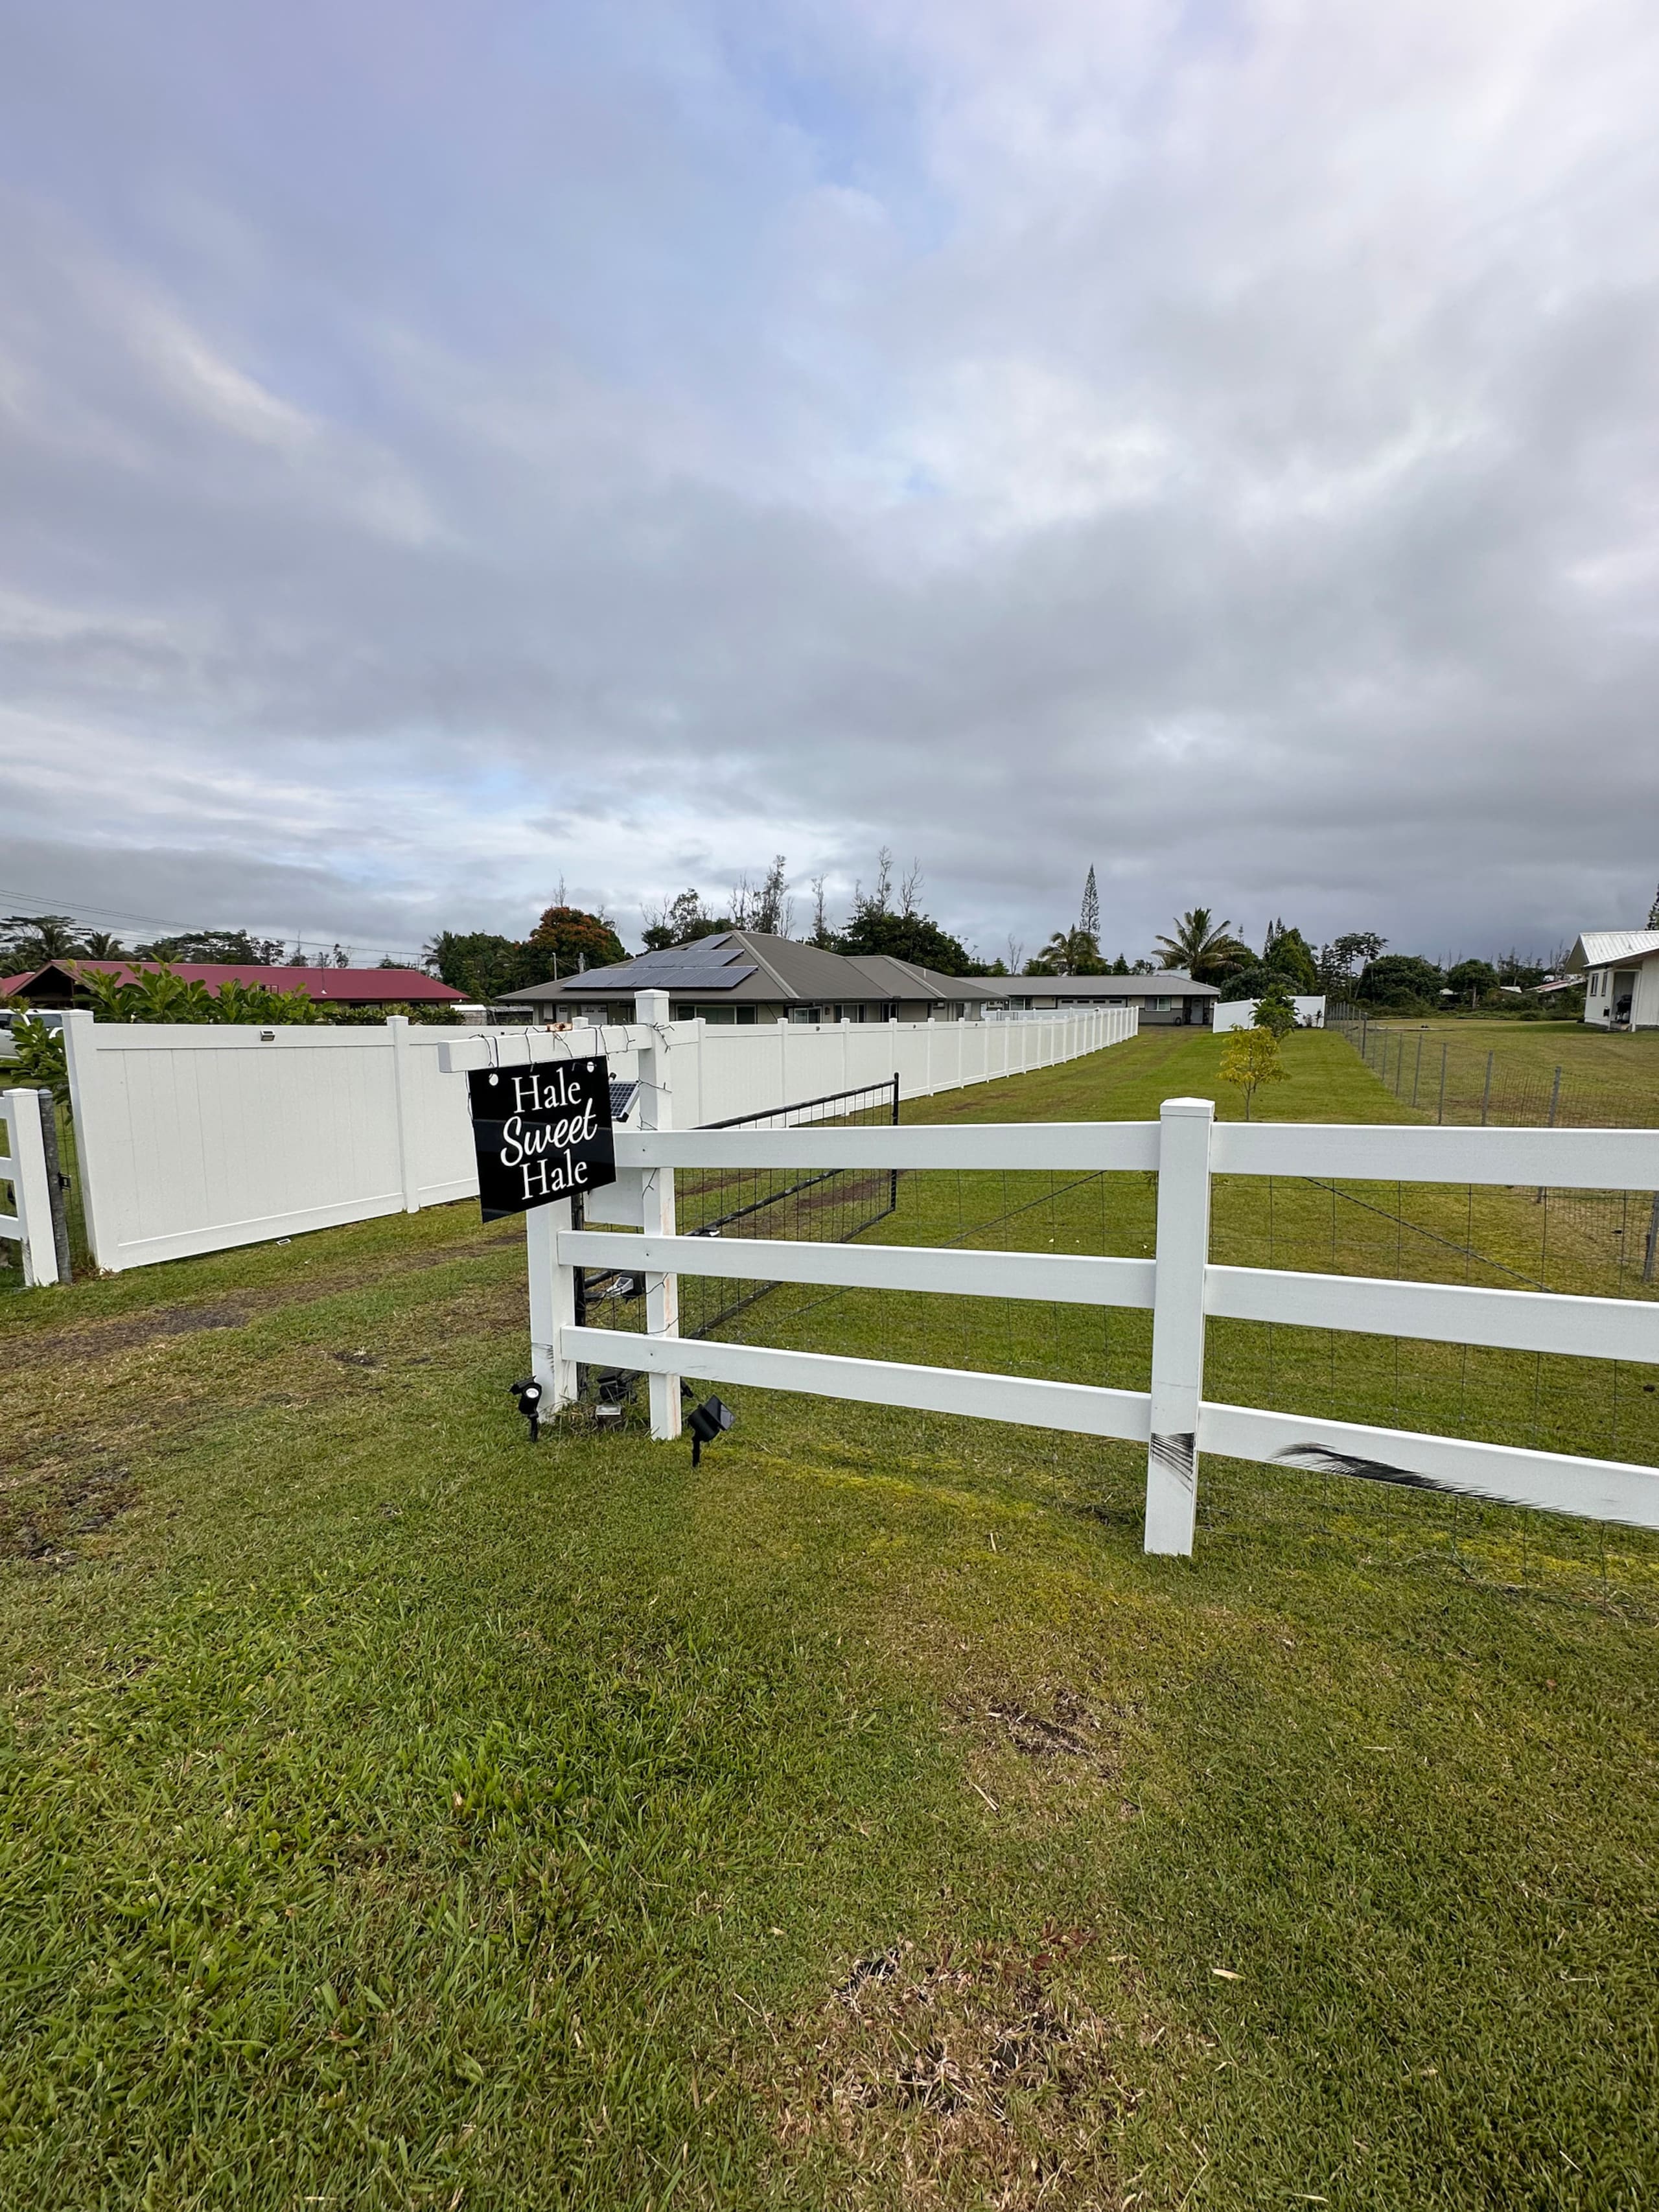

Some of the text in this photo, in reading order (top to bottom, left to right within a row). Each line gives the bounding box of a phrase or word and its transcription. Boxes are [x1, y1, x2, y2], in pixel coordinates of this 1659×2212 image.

[511, 1067, 582, 1114] Hale
[500, 1097, 598, 1167] Sweet
[520, 1148, 588, 1200] Hale
